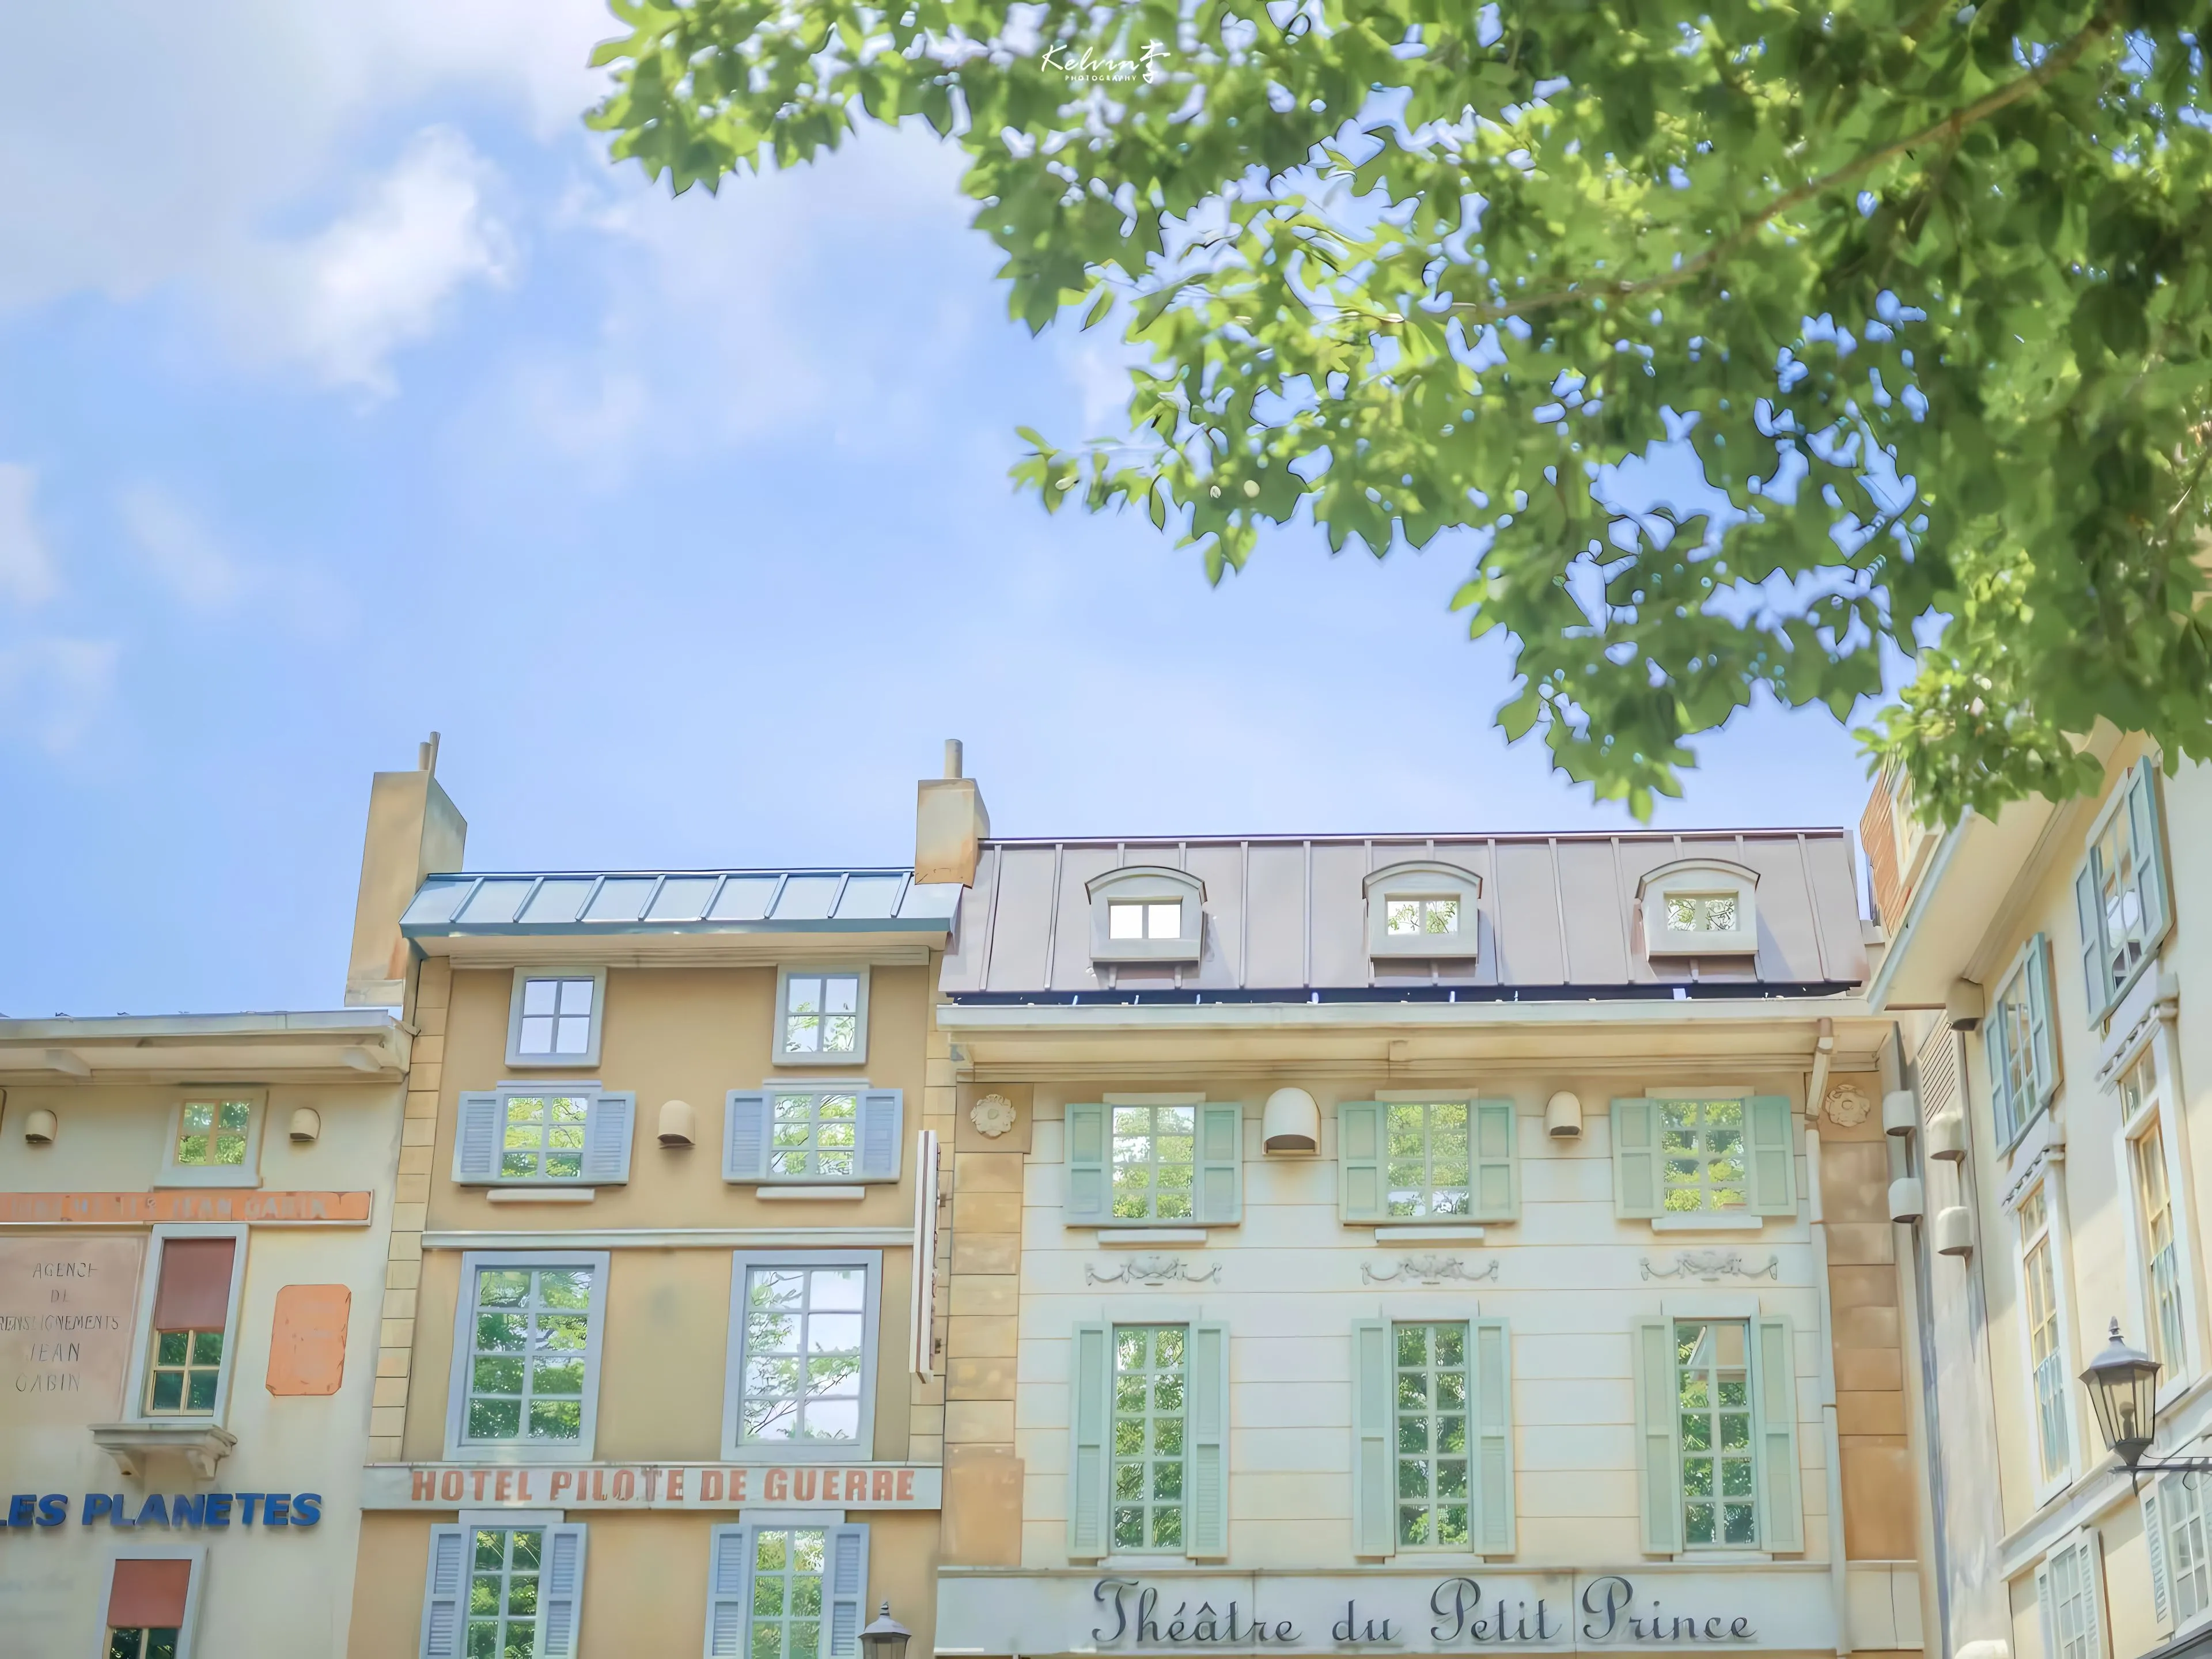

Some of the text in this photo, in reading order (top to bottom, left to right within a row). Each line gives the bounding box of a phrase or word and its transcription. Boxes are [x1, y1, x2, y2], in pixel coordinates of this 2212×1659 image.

[411, 1467, 915, 1502] HOTEL PILOTE DE GUERRE
[0, 1493, 322, 1528] ES PLANETES
[1092, 1575, 1758, 1642] Théâtre du Petit Prince
